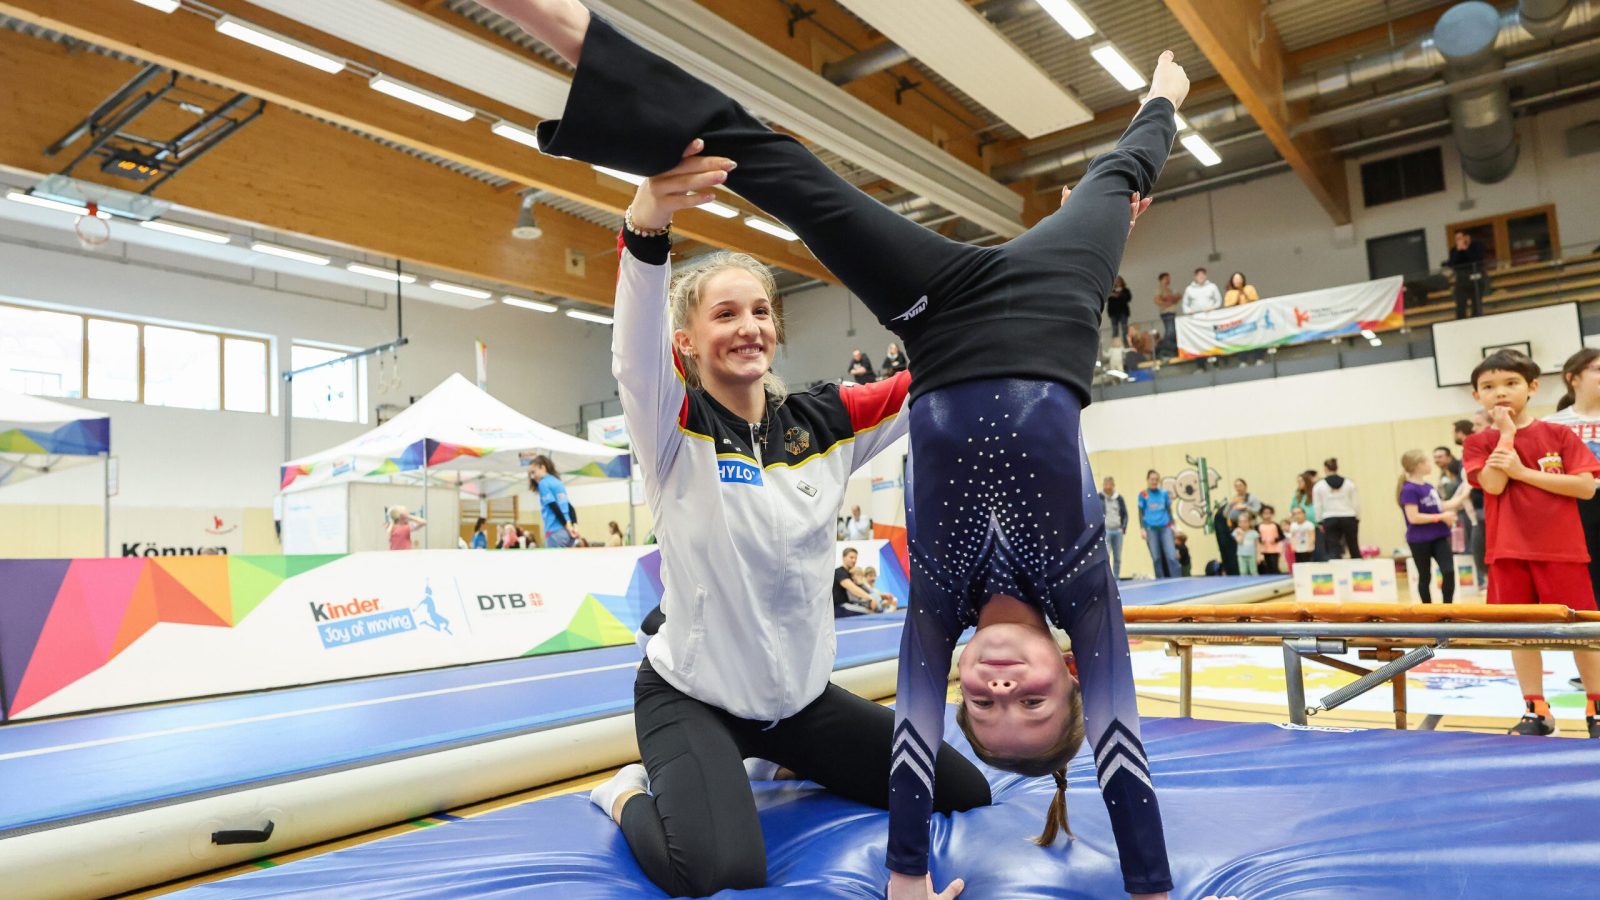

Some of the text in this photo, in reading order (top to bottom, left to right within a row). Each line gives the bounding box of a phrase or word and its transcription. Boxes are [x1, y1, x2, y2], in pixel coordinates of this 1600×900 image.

[121, 542, 228, 558] Könnn
[477, 593, 526, 611] DTB
[351, 620, 365, 637] of
[365, 614, 412, 635] moving
